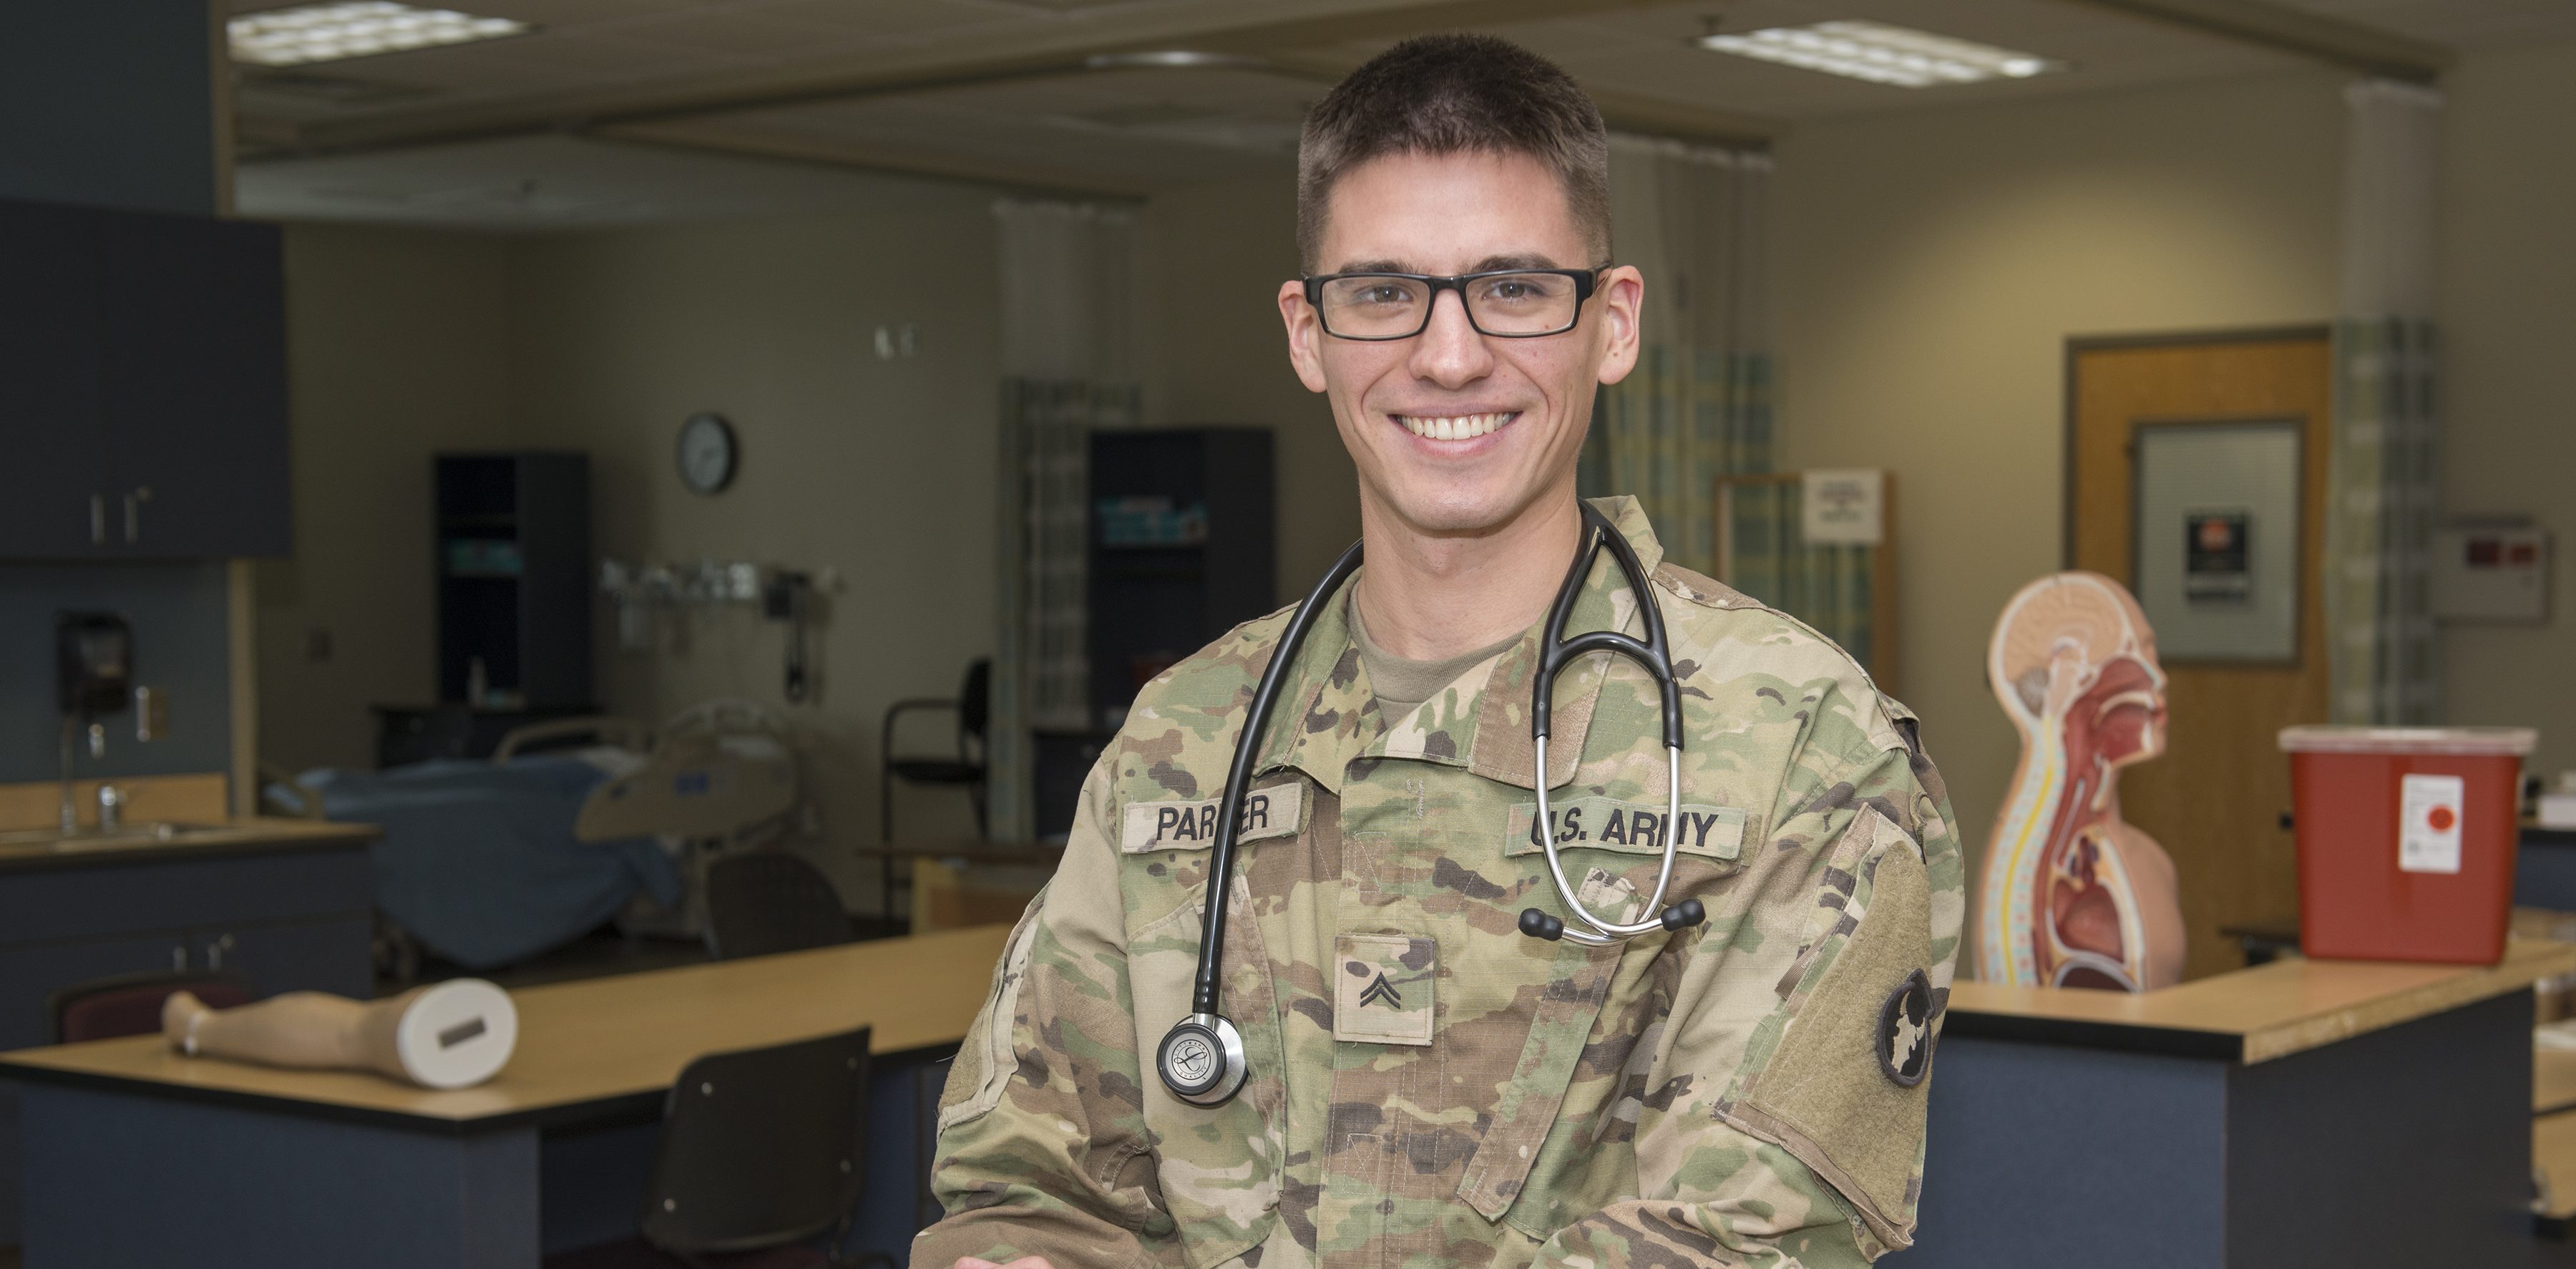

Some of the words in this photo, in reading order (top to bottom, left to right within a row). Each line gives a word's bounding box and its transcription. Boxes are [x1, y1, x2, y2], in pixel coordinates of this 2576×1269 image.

[1156, 794, 1269, 840] PARER
[1530, 807, 1587, 847] U.S.
[1600, 808, 1719, 847] ARMY
[1175, 1041, 1206, 1056] LITTMANN
[1180, 1066, 1207, 1079] QUALITY
